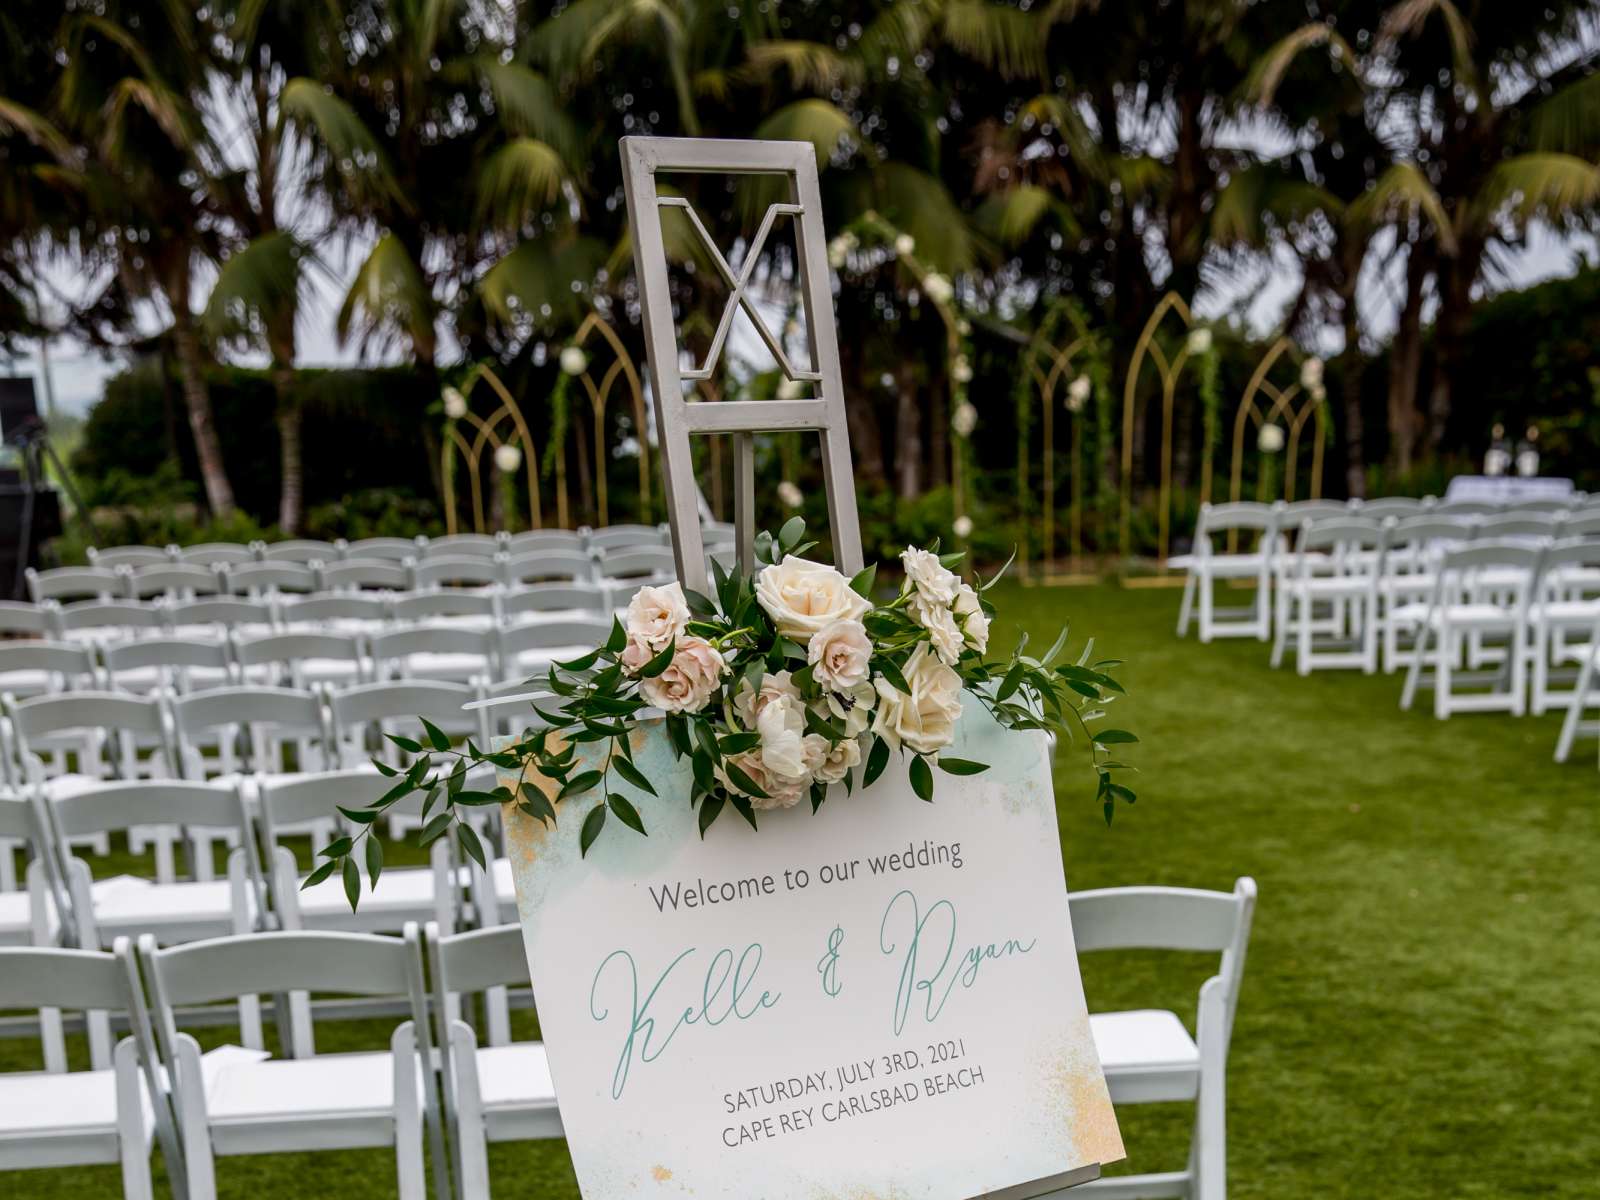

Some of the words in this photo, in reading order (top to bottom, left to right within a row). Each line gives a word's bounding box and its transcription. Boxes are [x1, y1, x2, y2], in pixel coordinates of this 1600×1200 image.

[649, 873, 775, 913] Welcome
[784, 867, 809, 893] to
[819, 857, 860, 885] our
[868, 840, 963, 876] wedding
[590, 943, 781, 1100] Kelle
[817, 924, 844, 998] &
[880, 890, 1037, 1036] Ryan
[722, 1115, 776, 1148] CAPE
[780, 1108, 815, 1132] REY
[821, 1083, 919, 1123] CARLSBAD
[924, 1065, 985, 1098] BEACH
[723, 1071, 833, 1114] SATURDAY,
[836, 1059, 875, 1092] JULY
[883, 1050, 925, 1077] 3RD,
[927, 1039, 966, 1064] 2021
